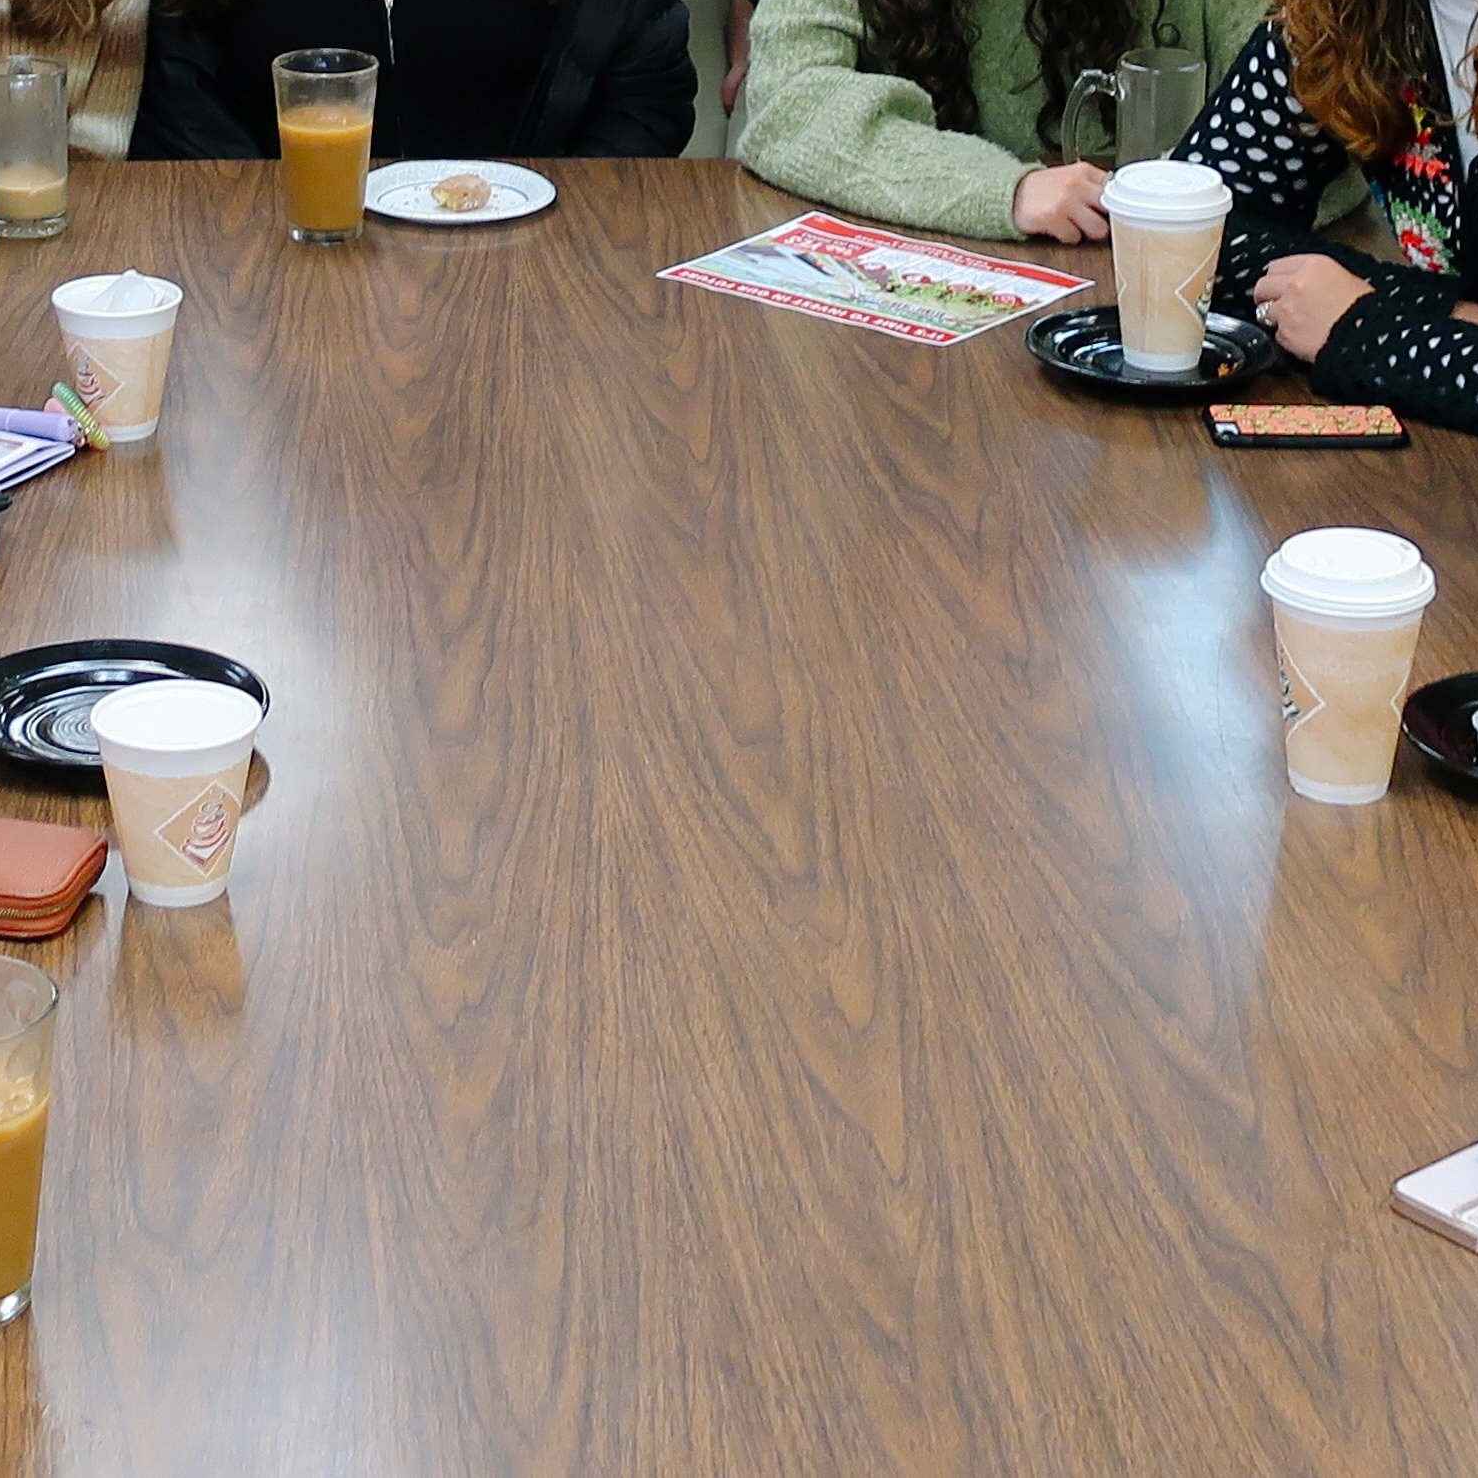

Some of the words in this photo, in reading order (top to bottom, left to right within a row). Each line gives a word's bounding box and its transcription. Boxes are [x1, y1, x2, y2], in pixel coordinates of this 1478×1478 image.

[679, 267, 736, 290] FUTURE
[737, 281, 769, 299] OUR
[769, 290, 790, 303] IN
[790, 295, 850, 319] INVEST
[850, 310, 871, 323] TO
[872, 317, 910, 335] TIME
[914, 325, 945, 341] IT'S
